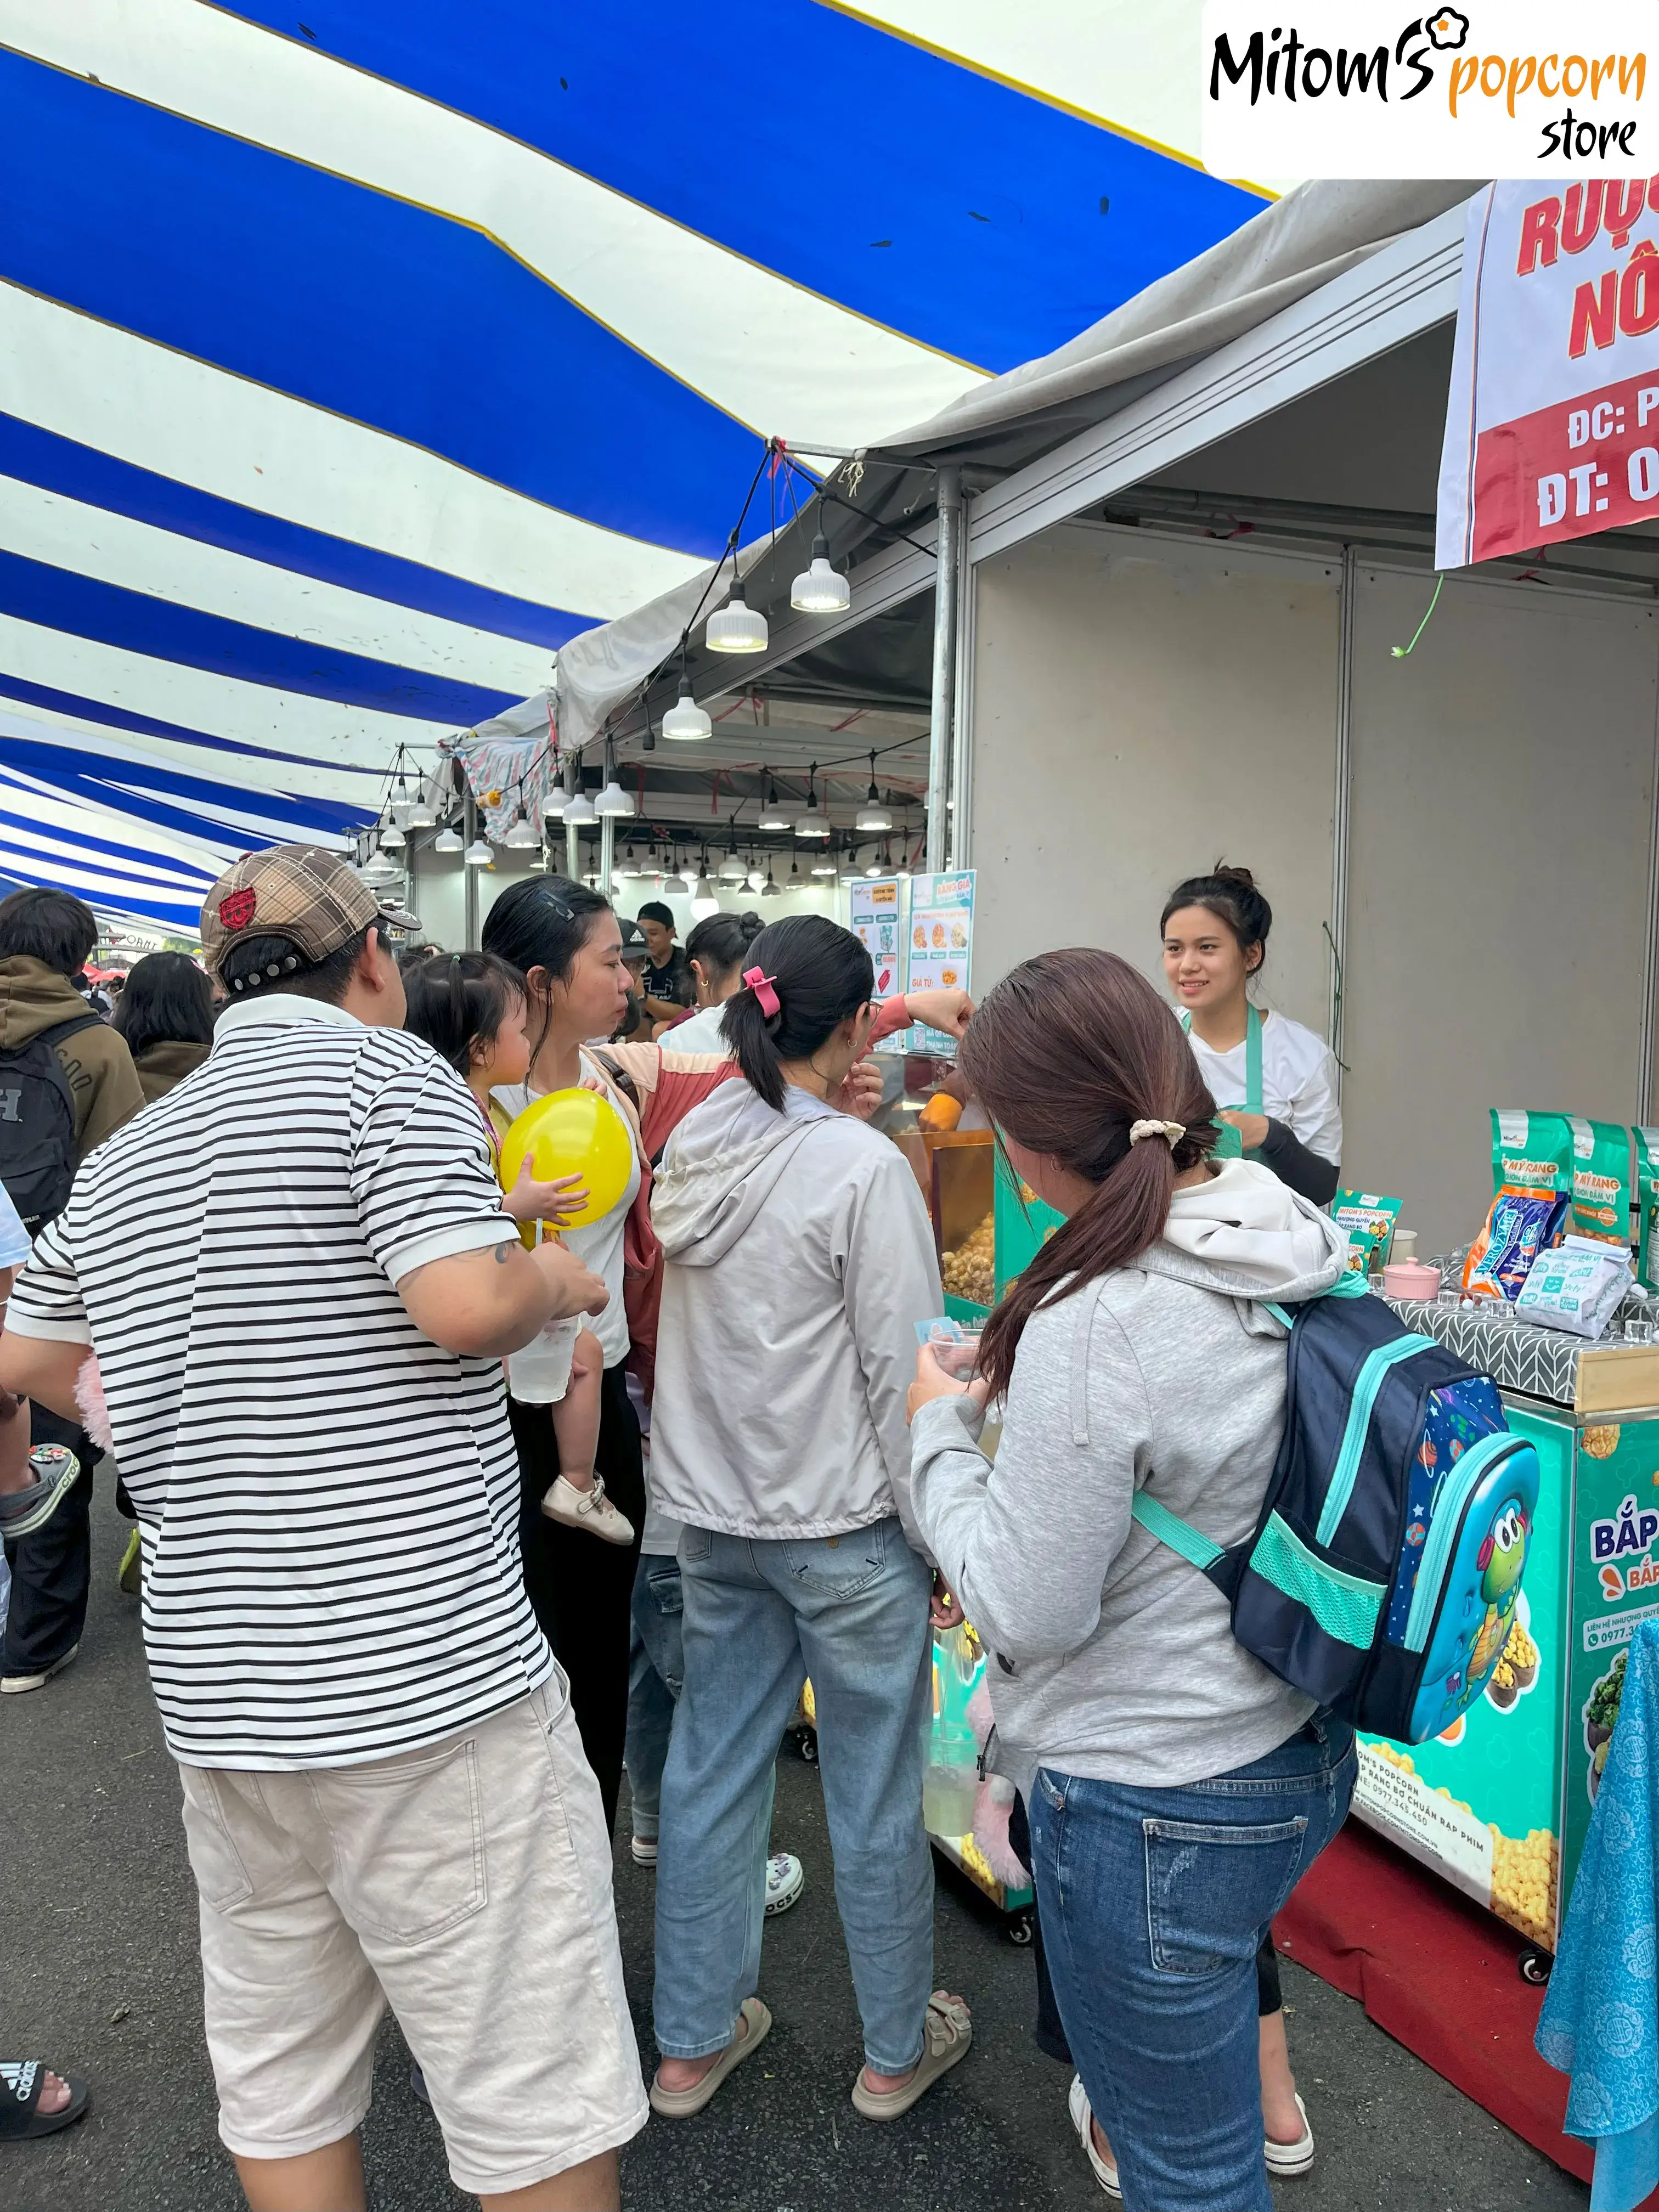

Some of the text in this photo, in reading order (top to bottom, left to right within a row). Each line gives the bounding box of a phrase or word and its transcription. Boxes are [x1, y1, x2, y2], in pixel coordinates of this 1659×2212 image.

[1567, 400, 1626, 449] ĐC:
[1537, 462, 1609, 528] ĐT:
[1525, 1163, 1557, 1173] RANG
[1592, 1177, 1620, 1190] RANG
[1595, 1500, 1658, 1558] BẮP
[1587, 1622, 1601, 1632] LIÊN
[1602, 1619, 1611, 1629] HỆ
[1612, 1613, 1641, 1626] NHƯỢNG
[1358, 1751, 1419, 1796] OM'S POPCORN
[1369, 1769, 1391, 1790] RANG
[1461, 1831, 1484, 1852] PHIM
[1373, 1784, 1427, 1826] 0977.345.450
